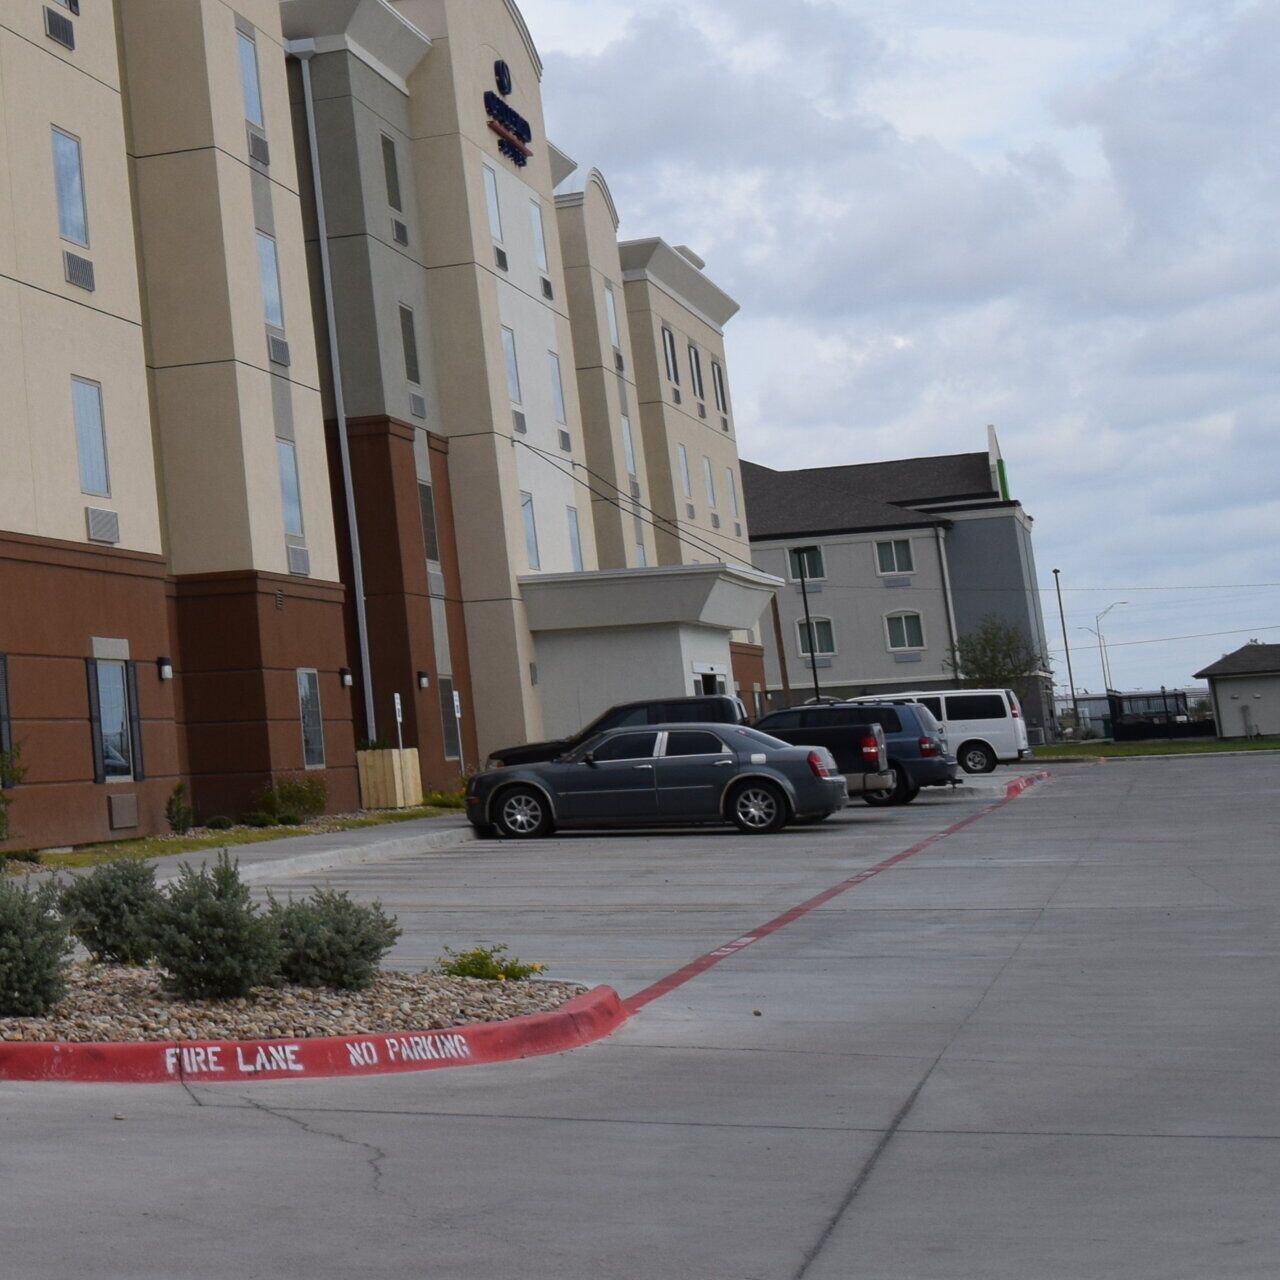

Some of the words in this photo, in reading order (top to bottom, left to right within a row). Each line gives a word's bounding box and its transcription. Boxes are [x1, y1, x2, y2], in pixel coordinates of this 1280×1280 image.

[164, 1046, 224, 1073] FIRE
[236, 1044, 304, 1071] LANE
[345, 1040, 378, 1067] NO
[384, 1033, 470, 1061] PARKING
